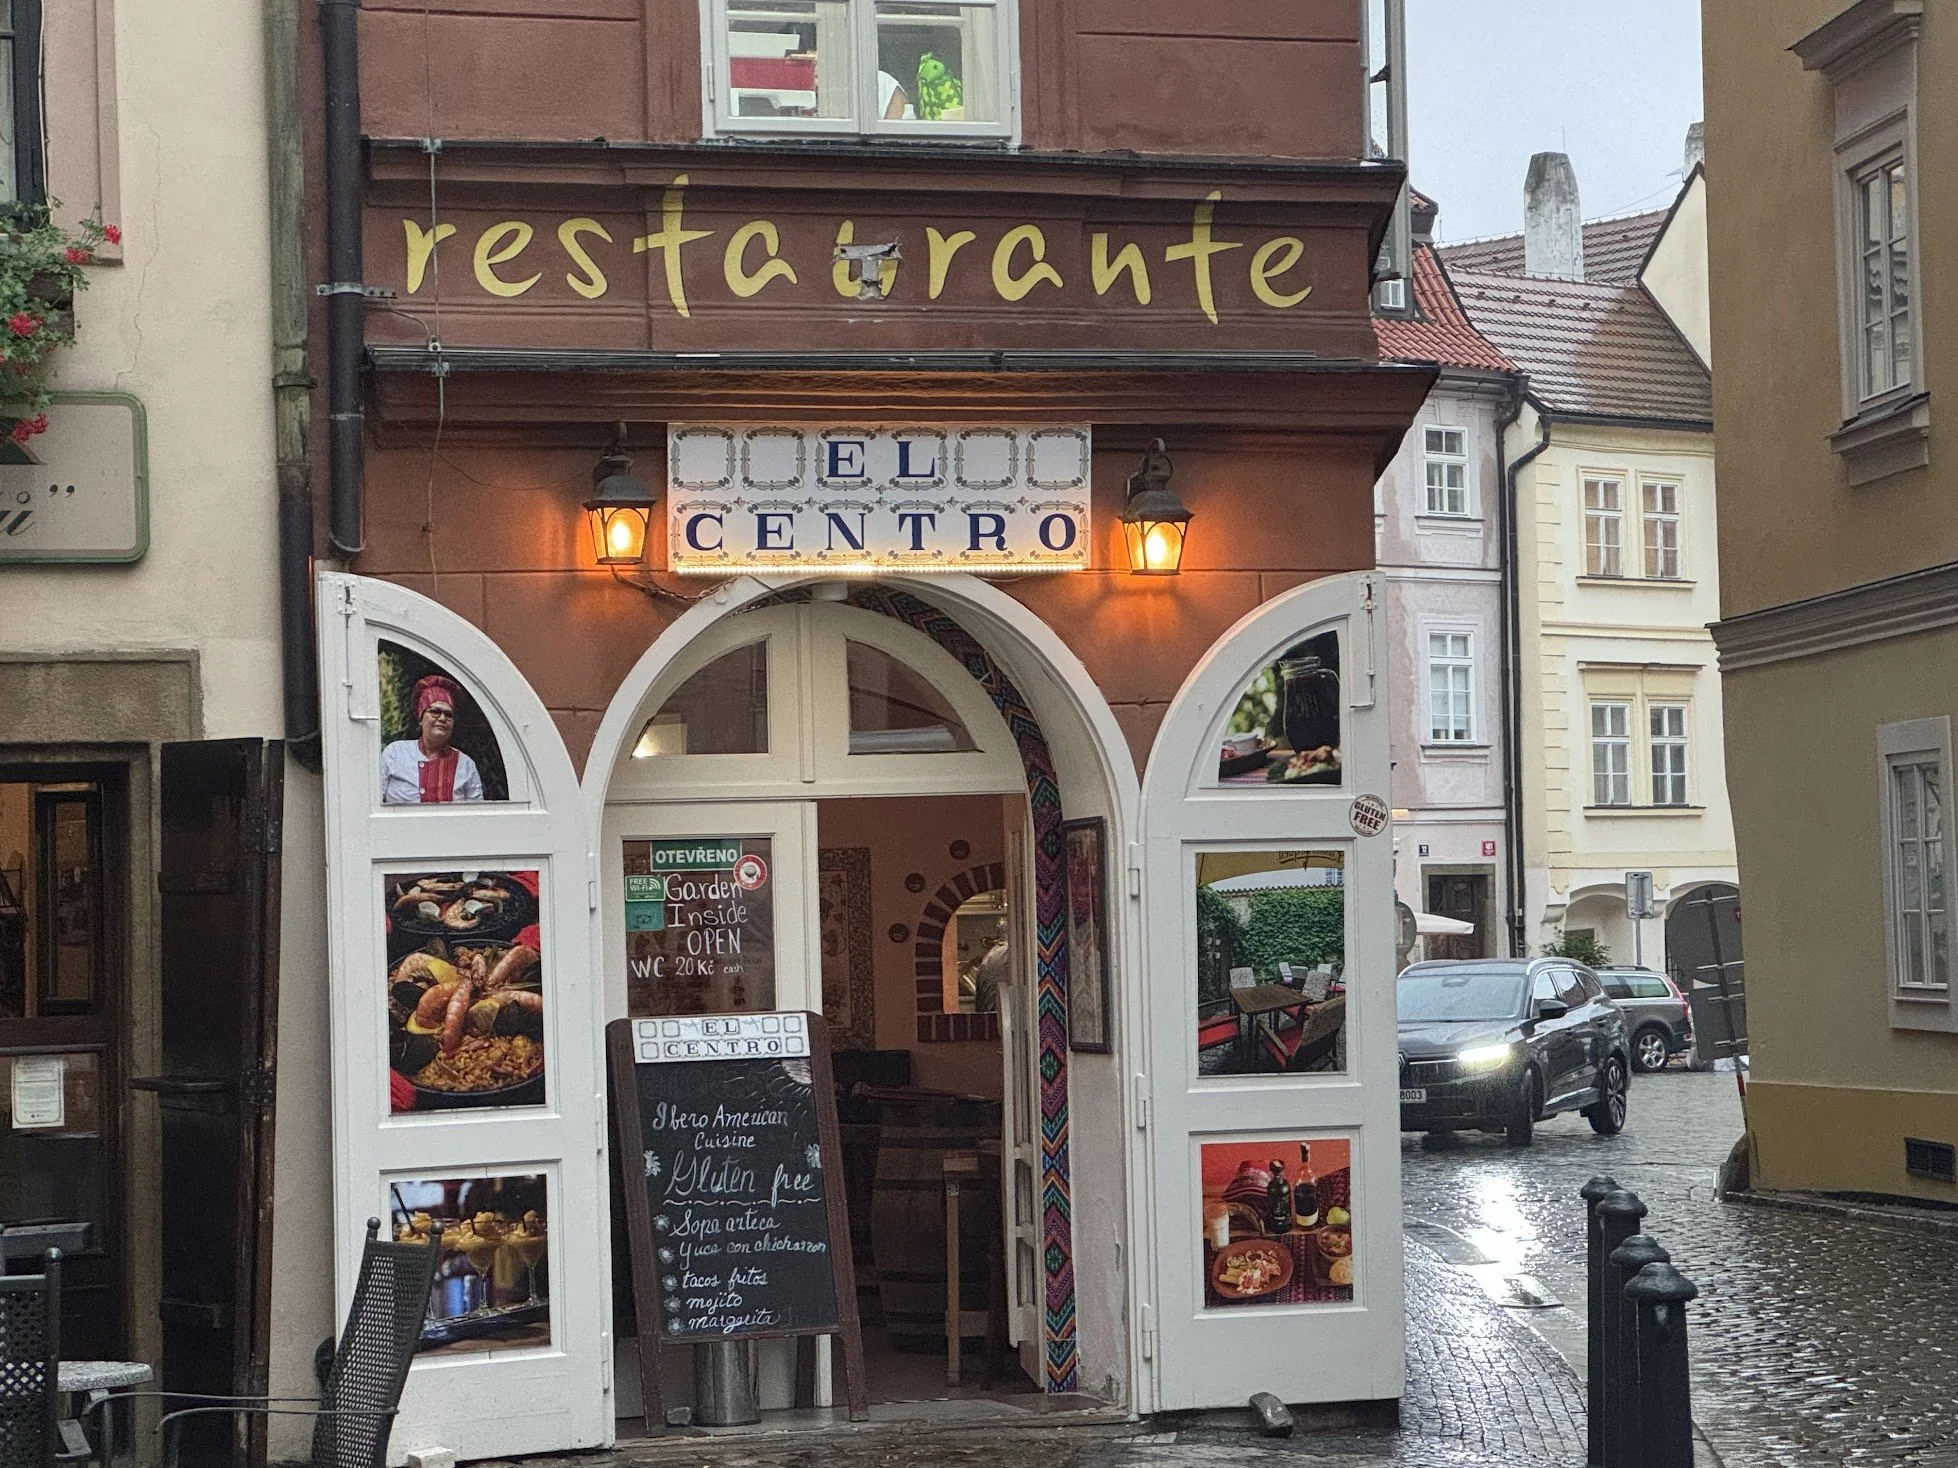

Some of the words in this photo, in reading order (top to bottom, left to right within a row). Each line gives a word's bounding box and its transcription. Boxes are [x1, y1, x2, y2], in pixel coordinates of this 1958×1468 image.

[403, 173, 1313, 325] restaurante
[826, 440, 936, 479] EL
[686, 512, 1077, 551] CENTRO
[1353, 811, 1381, 831] FREE
[1354, 801, 1386, 821] GLUTEN
[655, 846, 738, 864] OTEVŘENO
[629, 877, 648, 885] FREE
[665, 873, 743, 902] Garden
[667, 902, 749, 928] Inside
[687, 928, 741, 955] OPEN
[631, 956, 665, 979] WC
[723, 962, 745, 974] cash
[705, 1021, 738, 1034] EL
[667, 1040, 779, 1055] CENTRO
[653, 1102, 709, 1131] Ibero
[712, 1104, 788, 1128] American
[694, 1131, 756, 1150] Cuisine
[664, 1150, 756, 1196] Gluten
[771, 1163, 814, 1208] free
[669, 1209, 722, 1240] Sopa
[726, 1209, 781, 1231] azteca
[727, 1242, 751, 1253] con
[682, 1270, 721, 1289] tacos
[728, 1266, 768, 1291] fritos
[688, 1307, 781, 1334] margarita
